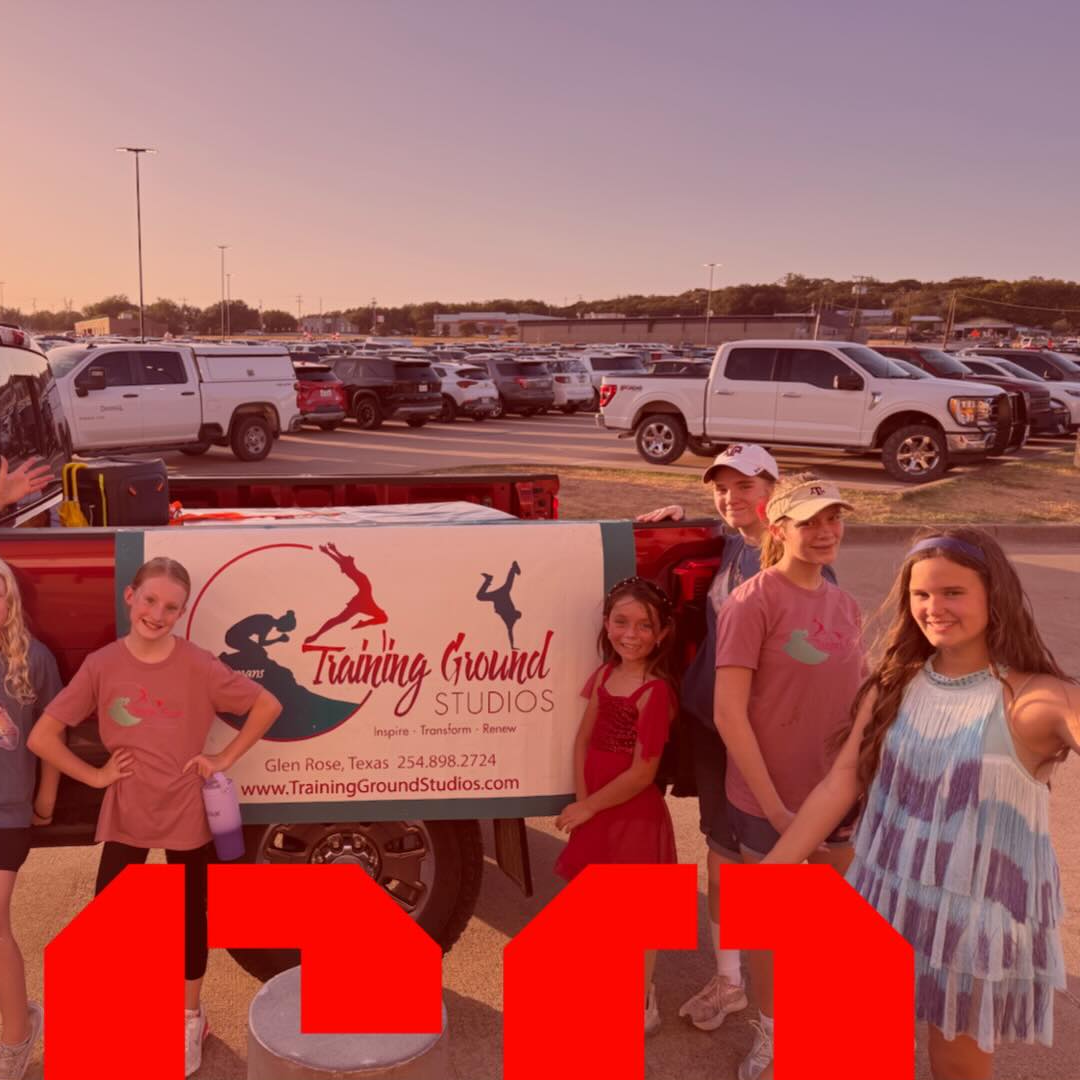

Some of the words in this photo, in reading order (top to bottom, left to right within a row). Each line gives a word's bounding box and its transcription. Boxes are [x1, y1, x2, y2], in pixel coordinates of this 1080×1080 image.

[302, 629, 432, 717] Training
[441, 630, 554, 686] Ground
[434, 689, 555, 716] STUDIOS
[373, 726, 409, 739] Inspire
[420, 723, 472, 736] Transform
[482, 723, 517, 735] Renew
[264, 758, 301, 773] Glen
[305, 757, 345, 773] Rose,
[348, 756, 390, 771] Texas
[396, 753, 497, 770] 254.898.2724
[240, 775, 520, 798] www.TrainingGroundStudios.com
